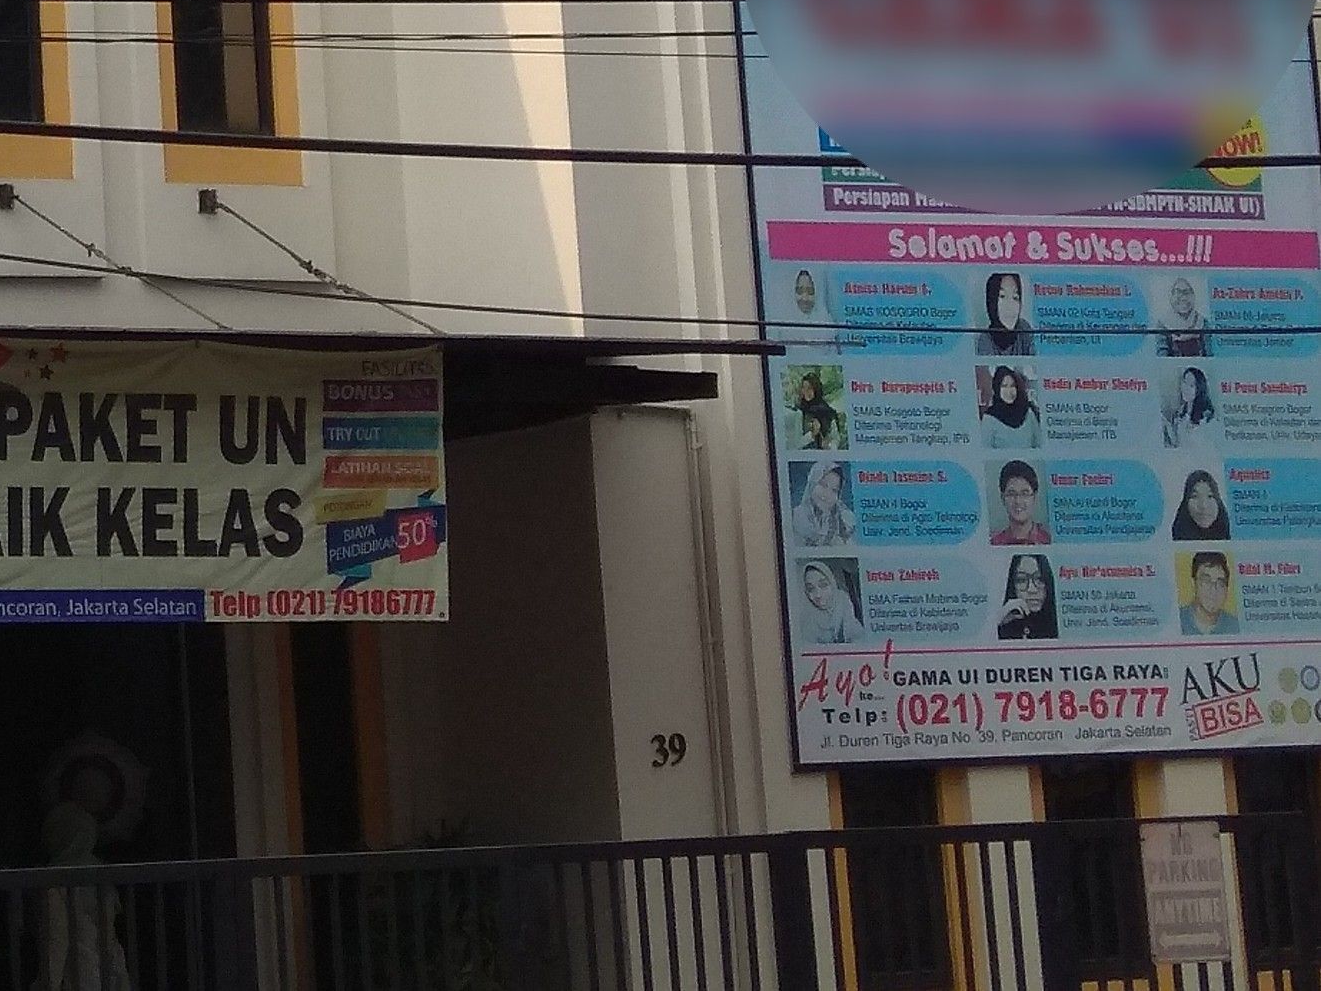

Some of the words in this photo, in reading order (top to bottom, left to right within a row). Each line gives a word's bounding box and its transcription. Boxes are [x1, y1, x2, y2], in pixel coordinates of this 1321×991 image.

[833, 187, 910, 209] Persiapan
[888, 227, 1016, 261] Selamat
[1027, 230, 1049, 260] &
[328, 384, 395, 402] BONUS
[219, 394, 307, 465] UN
[328, 426, 353, 442] TRY
[355, 426, 381, 442] OUT
[330, 462, 391, 475] LATIHAN
[96, 486, 304, 558] KELAS
[342, 523, 377, 542] BIAYA
[329, 534, 397, 562] PENDIDIKAN
[66, 597, 129, 616] Jakarta
[133, 597, 198, 616] Selatan
[210, 589, 261, 620] Telp
[265, 589, 327, 617] (021)
[330, 588, 437, 617] 79186777
[893, 668, 952, 687] GAMA
[958, 667, 978, 686] UI
[985, 667, 1053, 684] DUREN
[1059, 665, 1107, 682] TIGA
[1180, 652, 1260, 705] AKU
[821, 708, 888, 725] Telp:
[896, 690, 984, 734] (021)
[993, 686, 1169, 723] 7918-6777
[1200, 697, 1263, 732] BISA
[651, 732, 687, 768] 39
[839, 735, 879, 748] Duren
[882, 733, 911, 749] Tiga
[914, 732, 949, 747] Raya
[1074, 726, 1121, 741] Jakarta
[1124, 724, 1172, 738] Selatan
